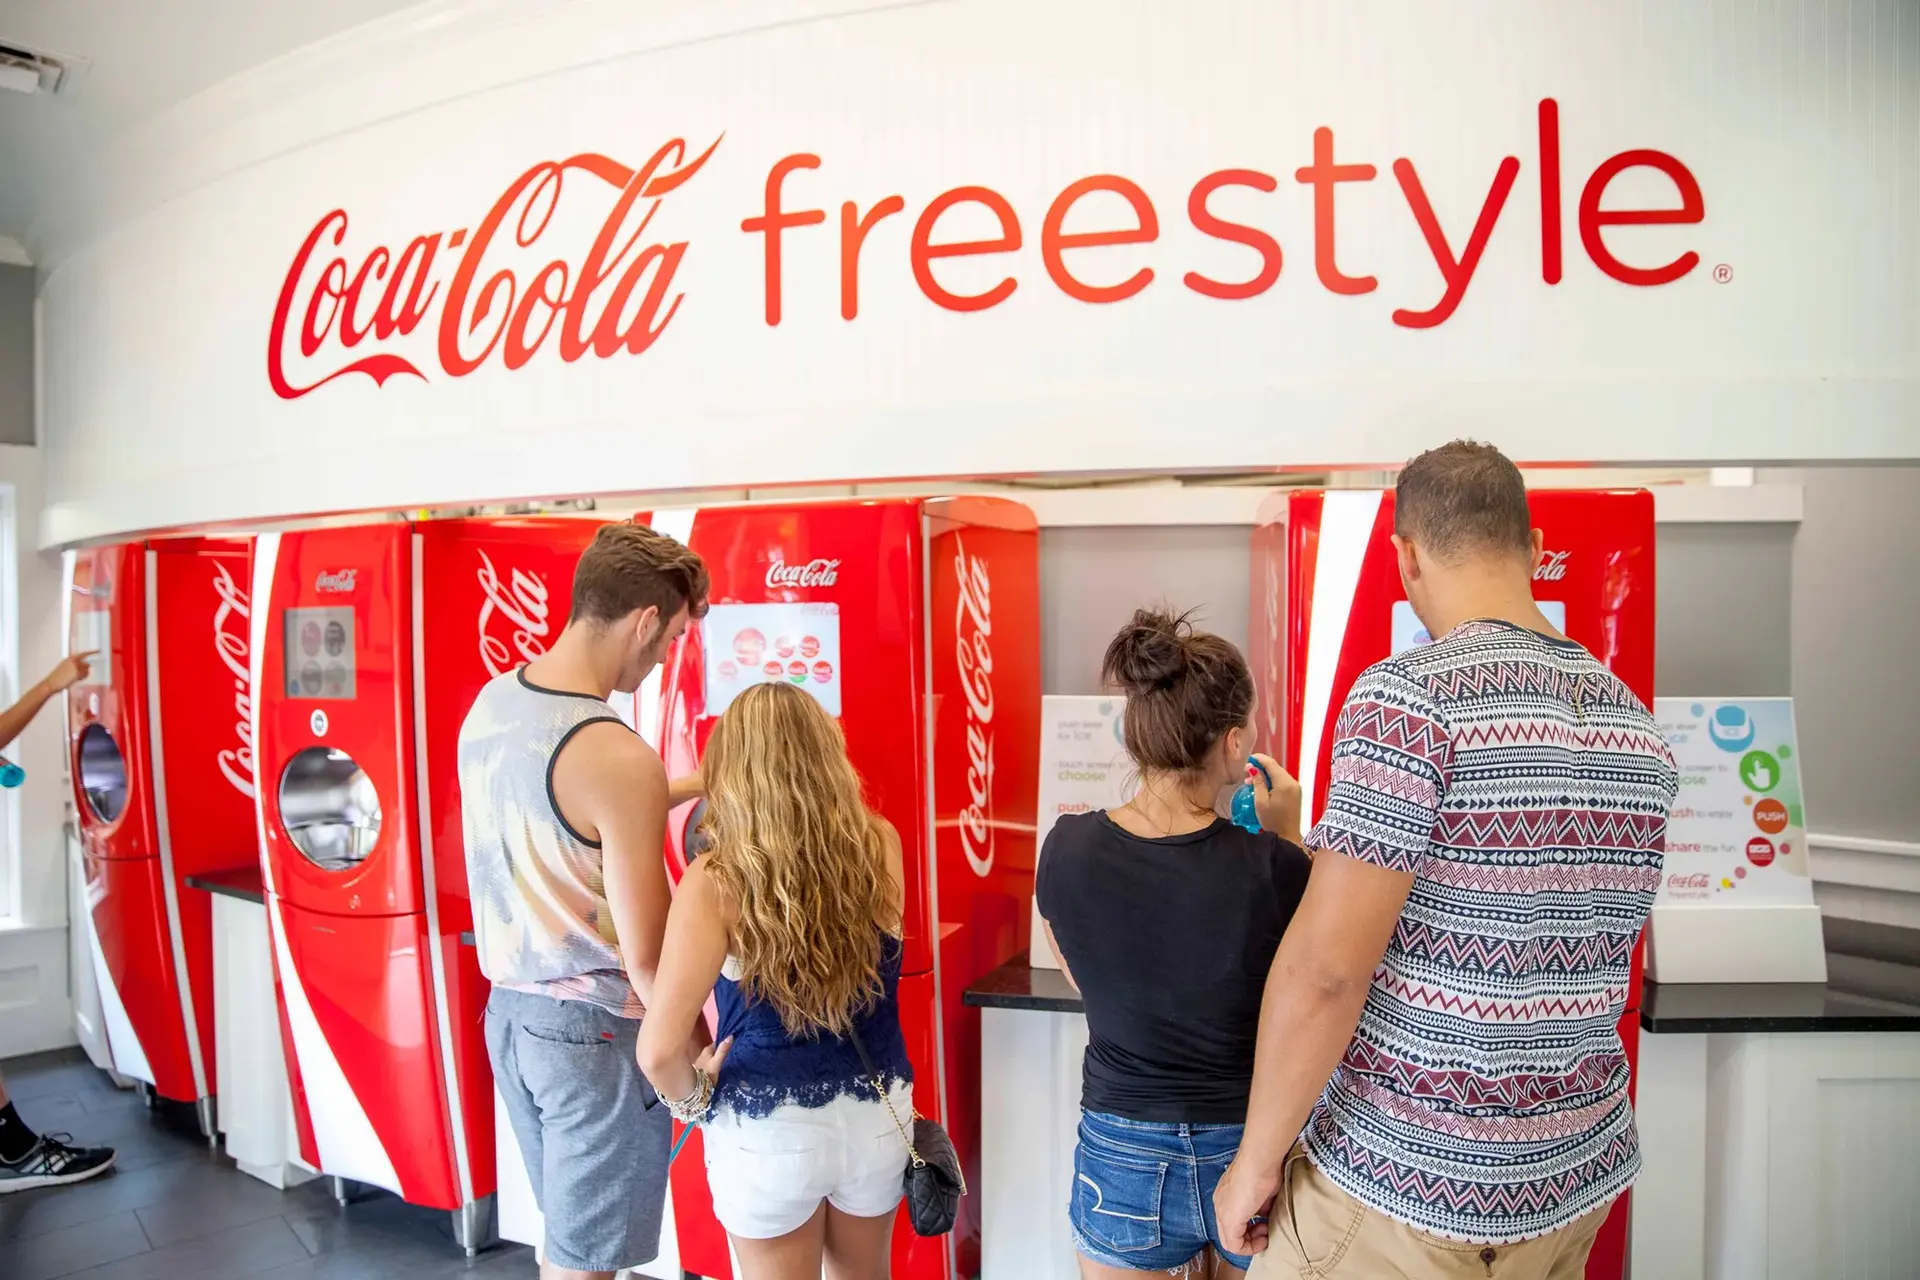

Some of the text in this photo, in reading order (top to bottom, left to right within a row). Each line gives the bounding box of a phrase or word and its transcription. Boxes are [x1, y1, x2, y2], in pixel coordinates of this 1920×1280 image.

[267, 129, 727, 400] Coca-Cola
[765, 558, 842, 589] Coca-Cola
[954, 531, 996, 878] Coca-Cola
[1057, 769, 1106, 781] choose
[1057, 802, 1090, 813] push
[1669, 805, 1695, 819] ush
[1756, 811, 1786, 822] PUSH
[1665, 841, 1702, 853] share
[1667, 872, 1710, 888] Coca-Cola
